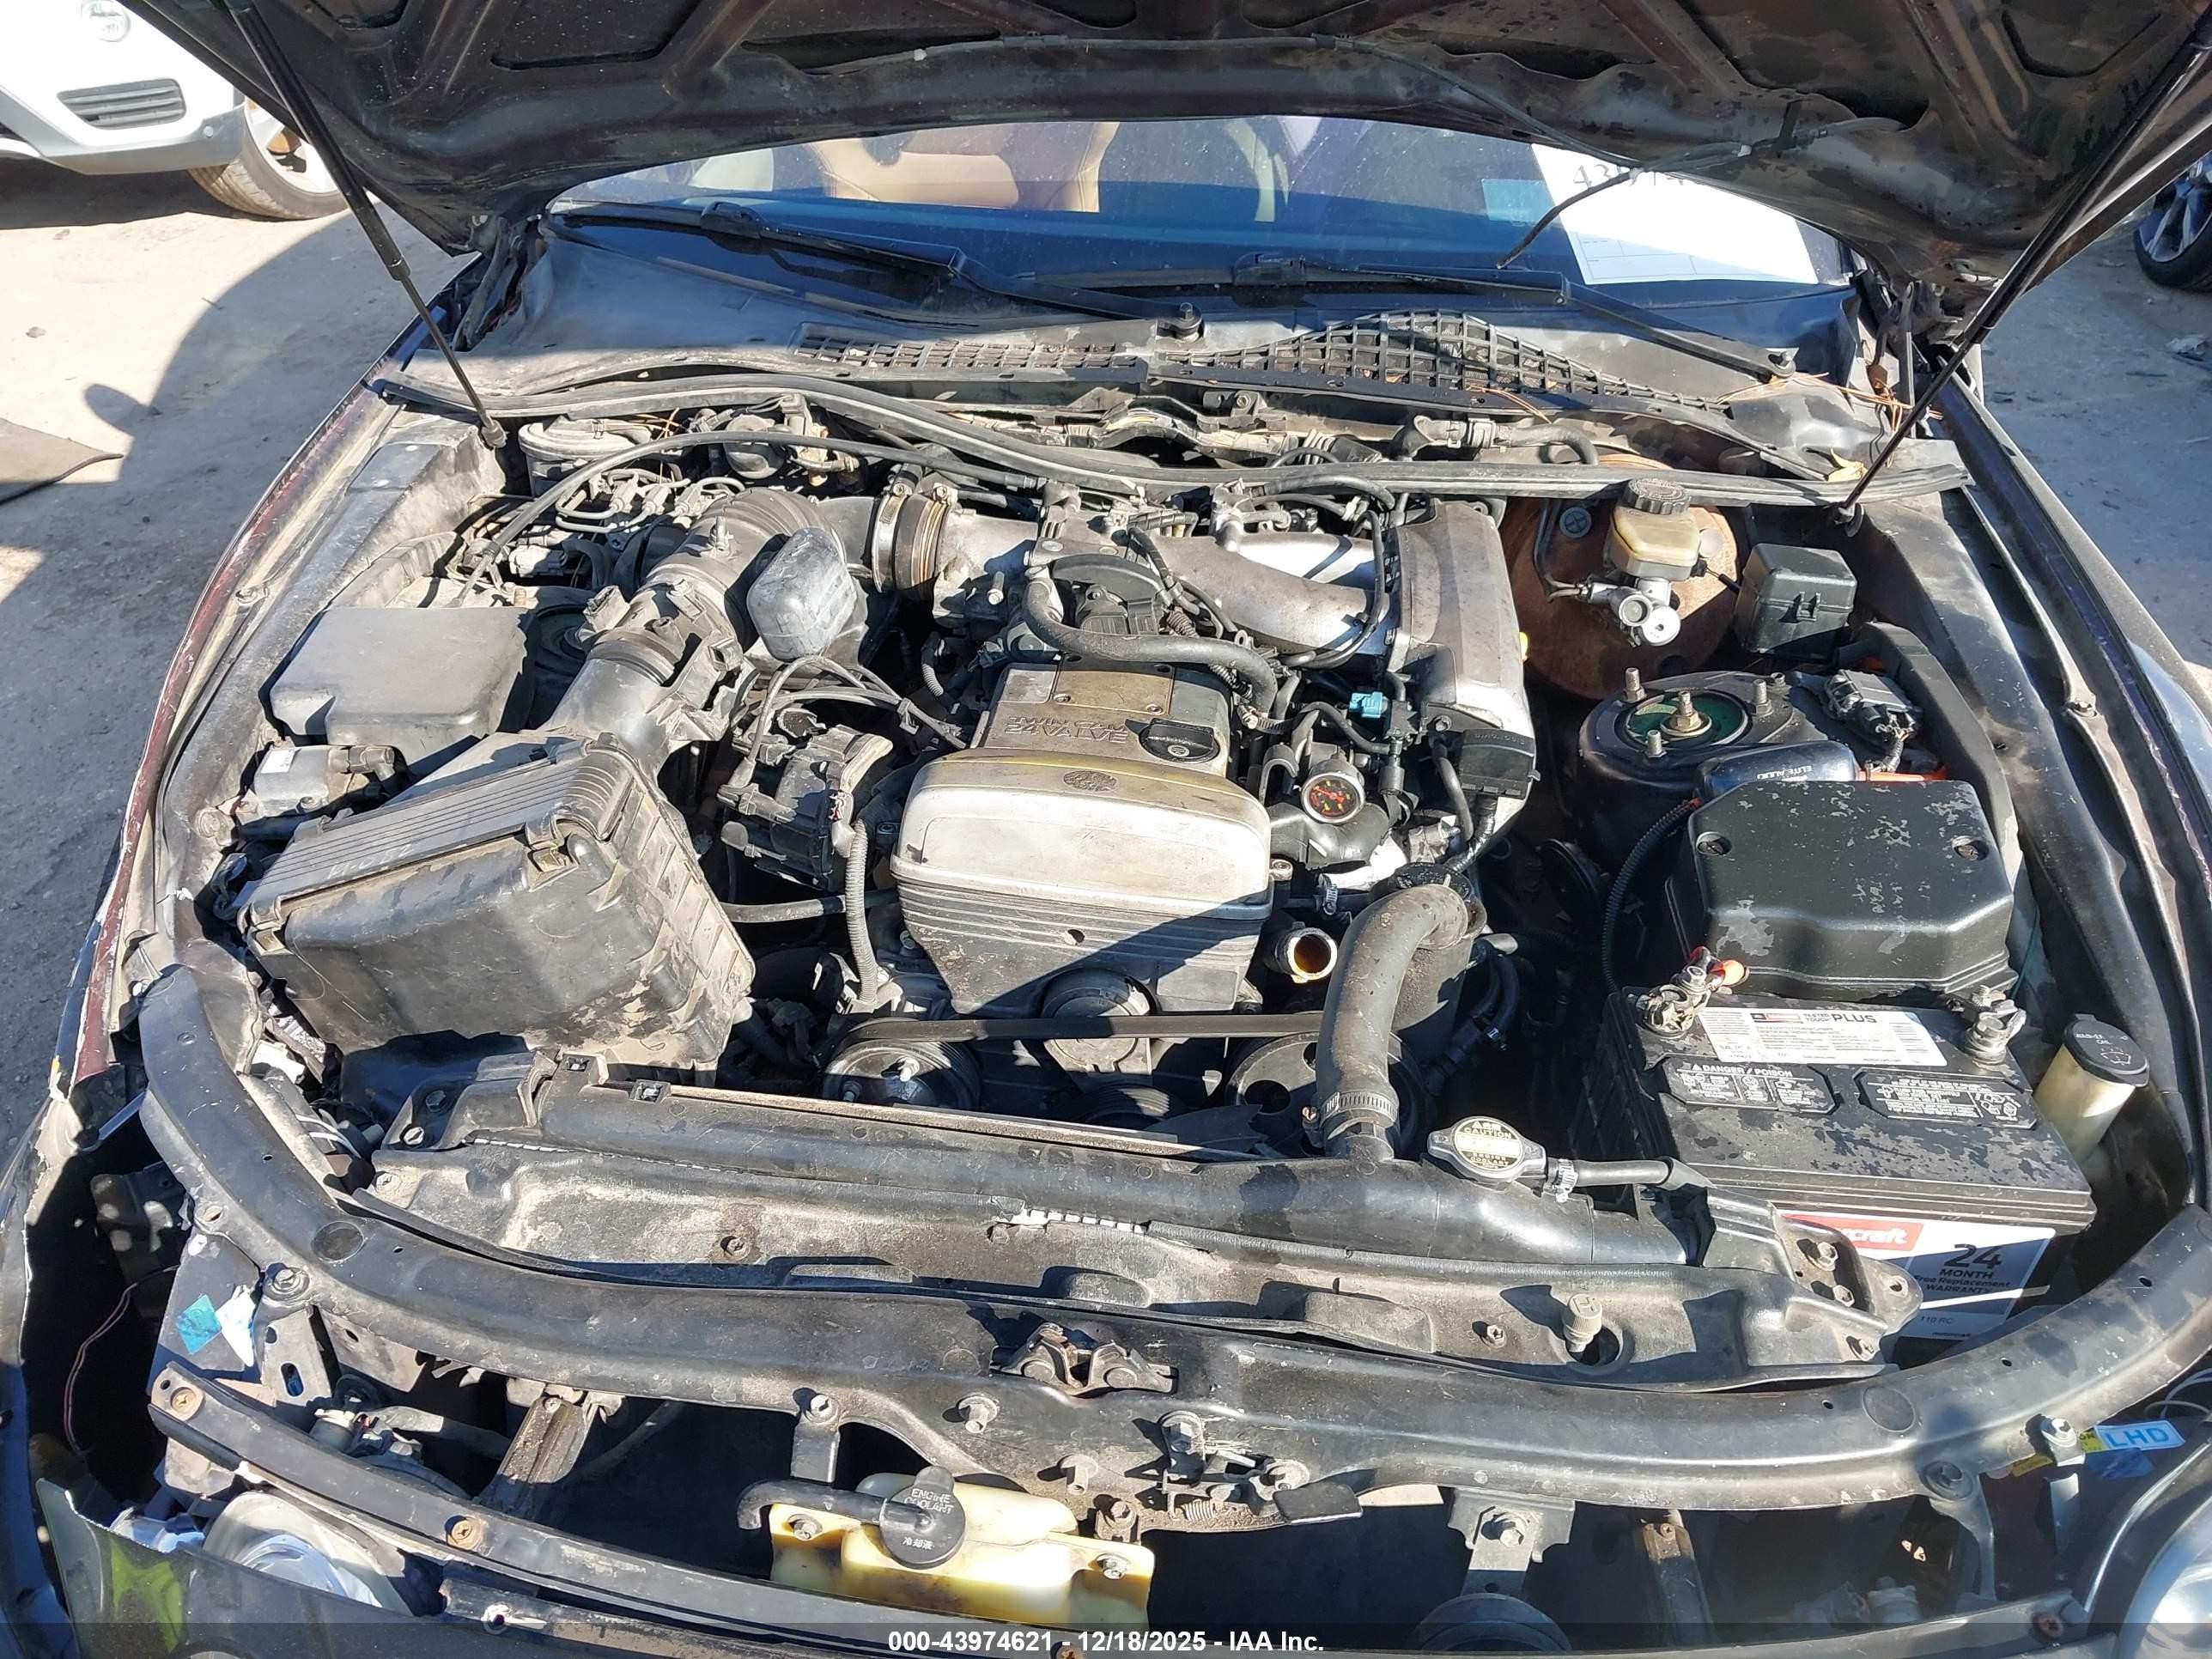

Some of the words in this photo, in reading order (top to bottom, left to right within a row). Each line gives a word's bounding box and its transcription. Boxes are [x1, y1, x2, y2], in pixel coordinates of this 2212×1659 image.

[1004, 723, 1039, 736] 24
[1042, 725, 1128, 744] VALVE
[1757, 769, 1785, 779] AUDIO
[1789, 765, 1813, 775] ELITE
[1832, 1013, 1877, 1024] PLUS
[1703, 1064, 1745, 1074] DANGER
[1753, 1068, 1794, 1078] POISON
[1464, 1127, 1512, 1139] CAUTION
[1943, 1243, 2002, 1270] 24
[1939, 1268, 1995, 1279] MONTH
[1913, 1274, 1936, 1284] Free
[1938, 1277, 2011, 1288] Replacement
[1926, 1284, 1993, 1295] WARRANTY
[2105, 1427, 2170, 1447] LHD
[910, 1488, 951, 1504] ENGINE
[903, 1497, 955, 1515] COOLANT
